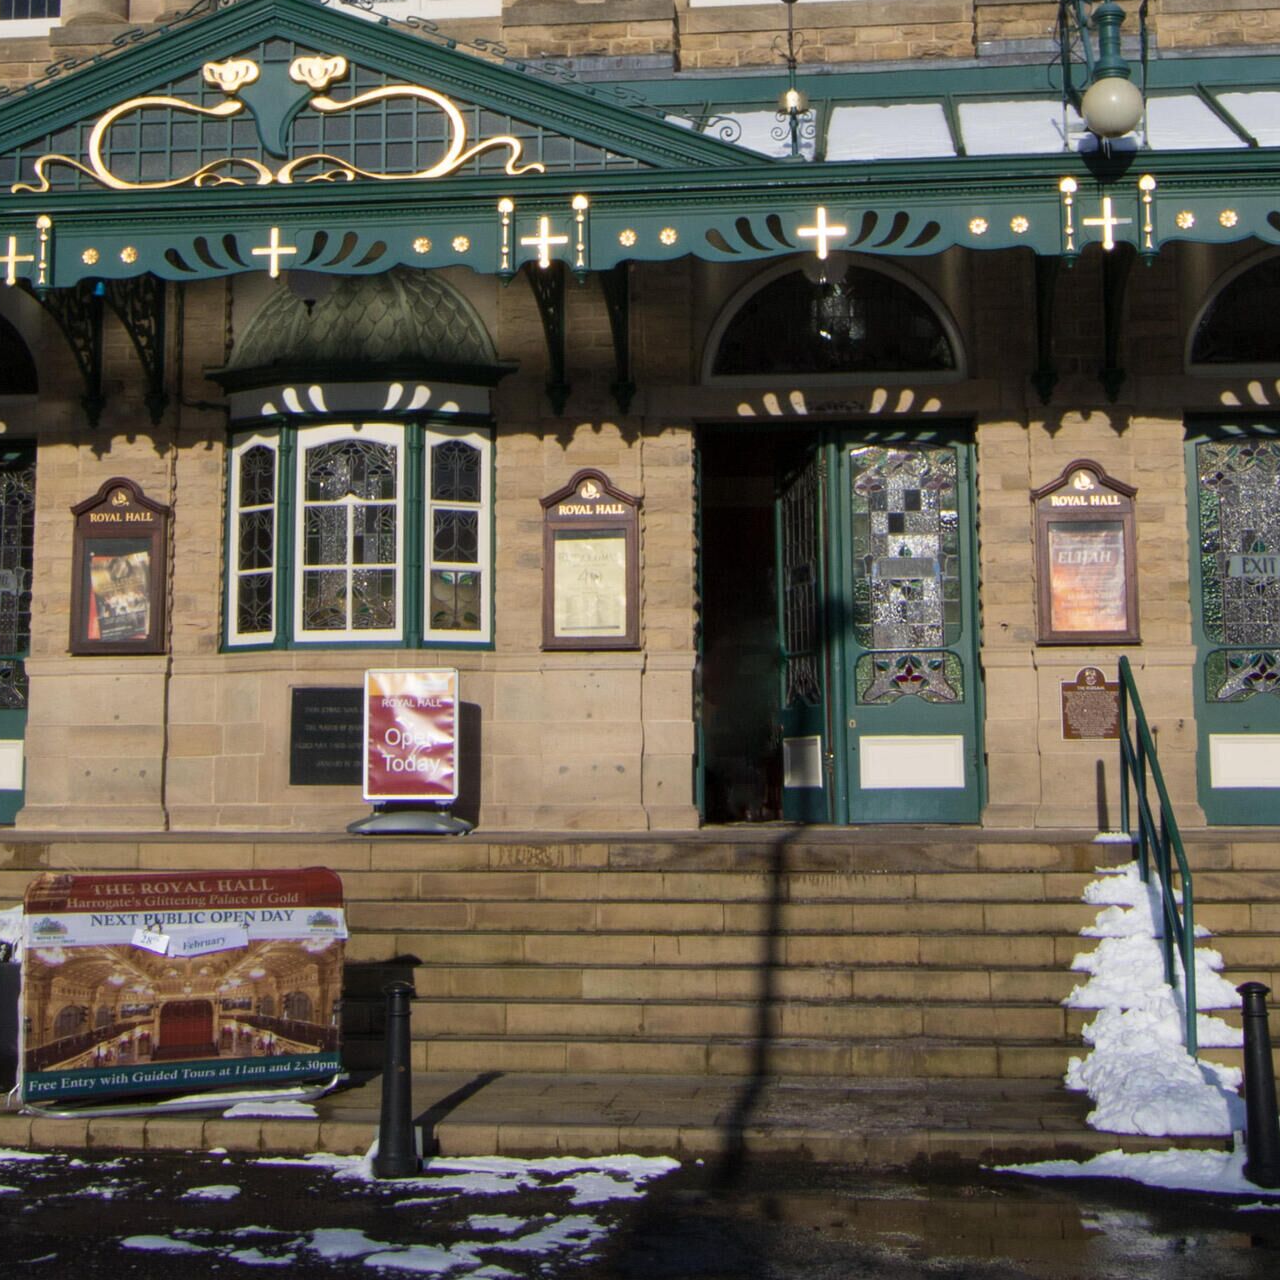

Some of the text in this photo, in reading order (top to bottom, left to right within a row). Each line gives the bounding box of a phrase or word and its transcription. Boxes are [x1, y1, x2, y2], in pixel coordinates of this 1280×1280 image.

[1051, 495, 1121, 506] ROYAL HALL
[89, 512, 153, 522] ROYAL HALL
[559, 504, 625, 515] ROYAL HALL
[1058, 551, 1112, 565] ELIJAH
[1242, 558, 1277, 573] EXIT
[382, 698, 442, 708] ROYAL HALL
[385, 728, 436, 750] Open
[382, 754, 441, 775] Today
[91, 878, 274, 896] THE ROYAL HALL
[66, 892, 299, 910] Harrogate's Glittering Palace of Gold
[91, 909, 295, 926] NEXT PUBLIC OPEN DAY
[183, 936, 225, 951] February
[28, 1080, 57, 1092] Free
[61, 1077, 96, 1089] Entry
[100, 1073, 128, 1085] with
[132, 1069, 178, 1082] Guided
[182, 1068, 215, 1080] Tours
[219, 1065, 230, 1076] at
[235, 1063, 266, 1074] 11am
[269, 1062, 291, 1073] and
